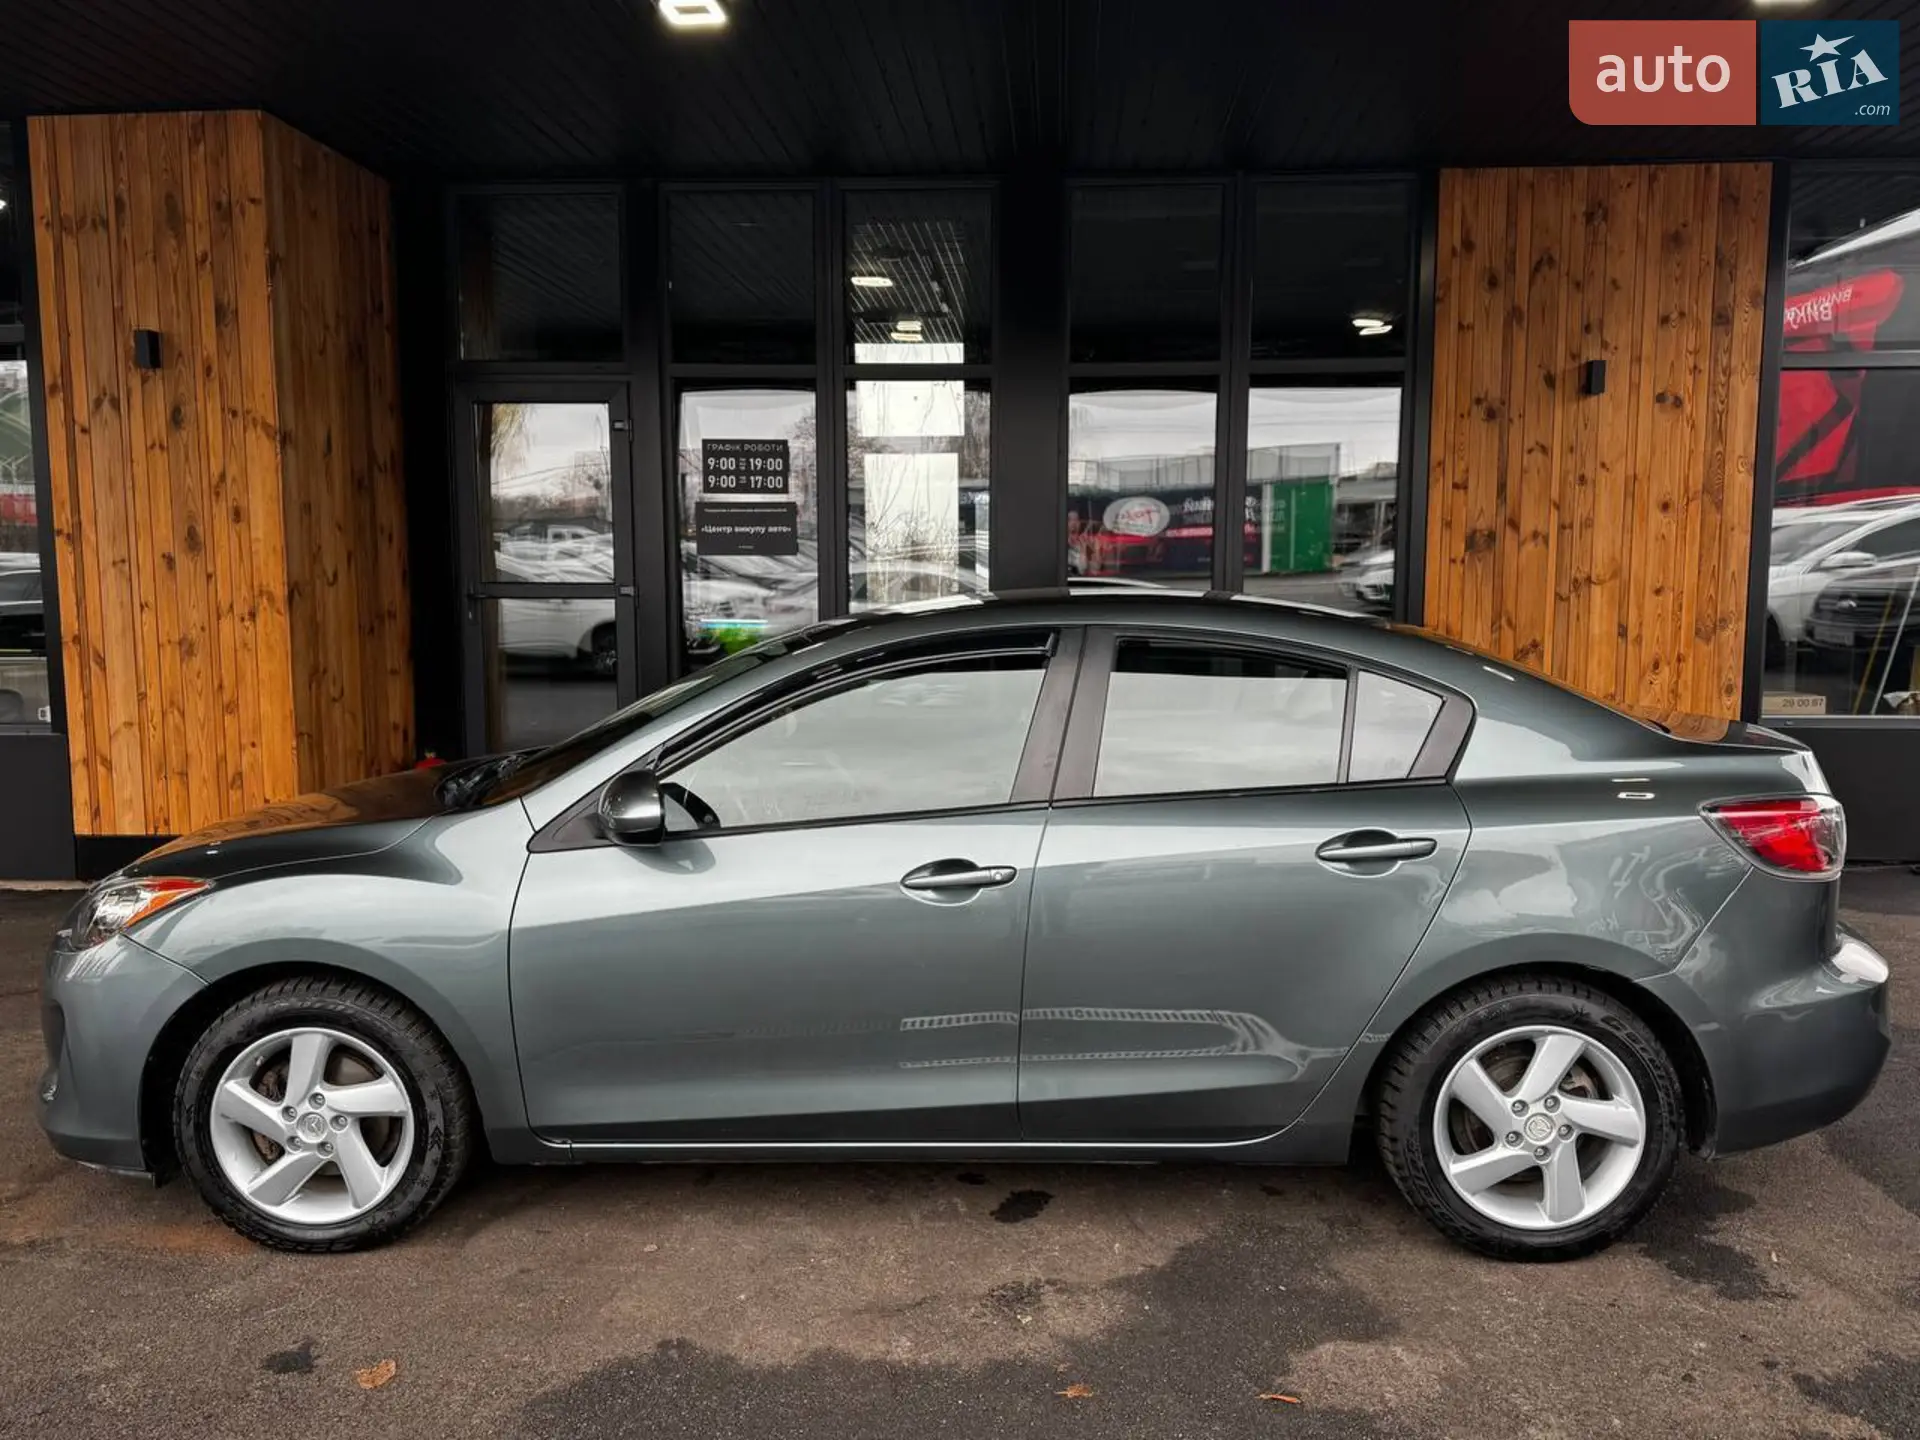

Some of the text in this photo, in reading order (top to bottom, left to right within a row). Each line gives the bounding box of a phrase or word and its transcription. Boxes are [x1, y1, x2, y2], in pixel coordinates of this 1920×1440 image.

[707, 443, 783, 452] ГРАФІК РОБОТИ
[707, 457, 736, 471] 9:00
[749, 457, 783, 471] 19:00
[707, 475, 736, 488] 9:00
[749, 475, 783, 489] 17:00
